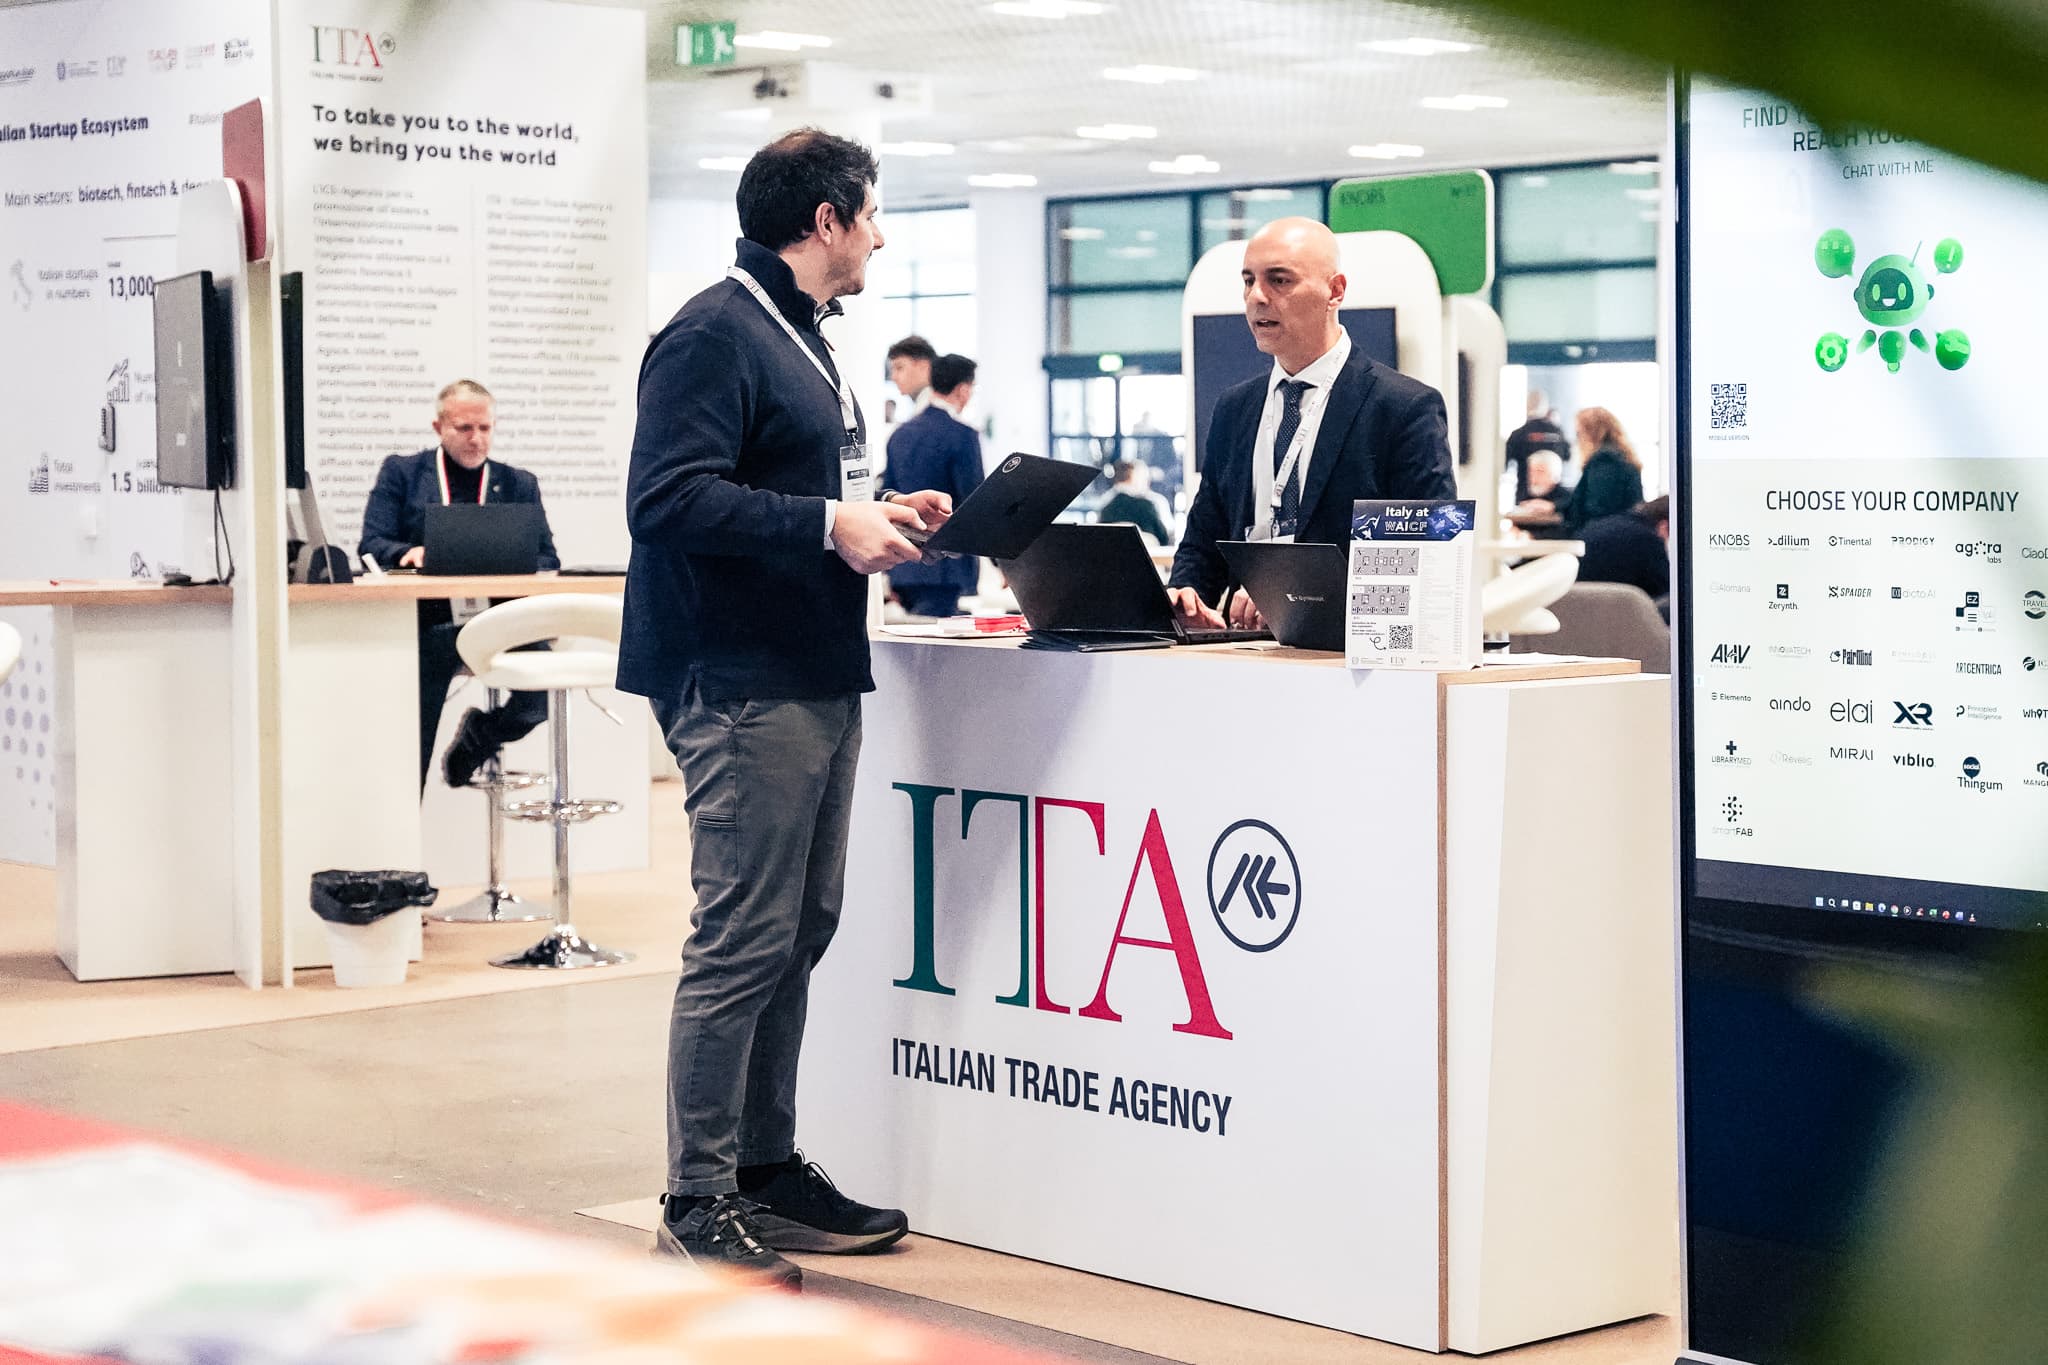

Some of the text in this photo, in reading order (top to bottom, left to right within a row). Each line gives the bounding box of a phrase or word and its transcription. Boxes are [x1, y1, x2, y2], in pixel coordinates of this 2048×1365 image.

[309, 24, 383, 68] ITA
[313, 105, 579, 143] To take you to the world,
[1743, 105, 1789, 128] FIND
[30, 122, 78, 140] Startup
[81, 117, 149, 136] Ecosystem
[1793, 127, 1914, 152] REACH YOU
[313, 134, 557, 166] we bring you the world
[1843, 159, 1935, 179] CHAT WITH ME
[5, 191, 30, 206] Main
[127, 181, 166, 199] fintech
[170, 180, 178, 195] &
[109, 275, 154, 301] 13,000
[112, 472, 132, 492] 1.5
[1385, 505, 1430, 520] Italy at
[1766, 490, 2020, 512] CHOOSE YOUR COMPANY
[1384, 521, 1428, 532] WAICF
[1709, 534, 1750, 546] KNOBS
[1838, 536, 1872, 546] Tinental
[1720, 693, 1752, 702] Elemento
[1769, 696, 1811, 712] aindo
[1829, 698, 1874, 724] elai
[1893, 701, 1933, 726] XR
[1957, 776, 2003, 794] Thingum
[892, 782, 1234, 1041] ITA
[892, 1037, 1233, 1137] ITALIAN TRADE AGENCY
